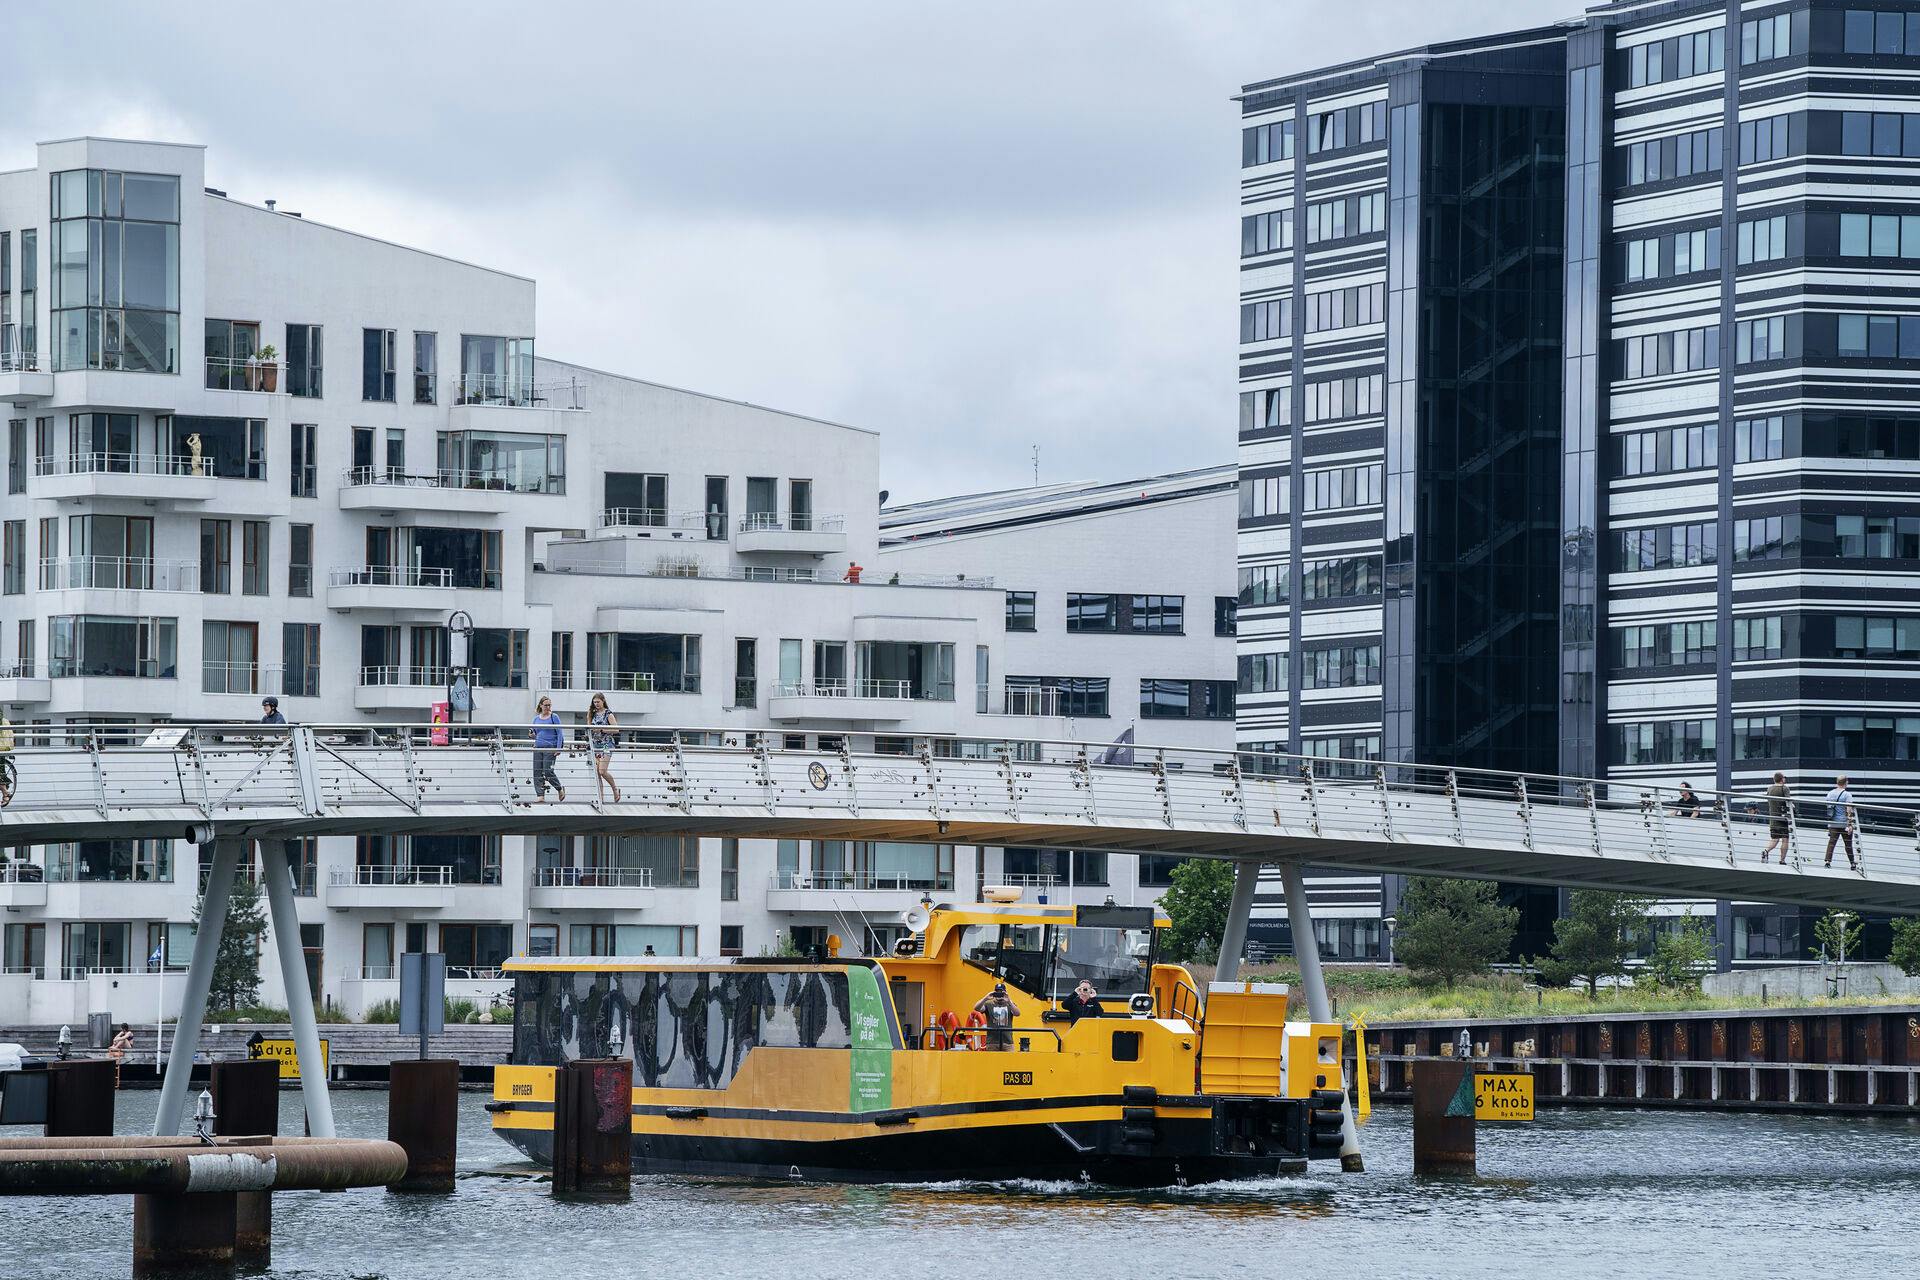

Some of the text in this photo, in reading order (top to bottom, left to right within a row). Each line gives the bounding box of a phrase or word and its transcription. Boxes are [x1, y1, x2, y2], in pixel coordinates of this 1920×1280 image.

[1004, 1073, 1031, 1084] PAS 80
[1483, 1078, 1523, 1092] MAX.
[512, 1084, 533, 1096] BRYGGEN
[1475, 1094, 1529, 1109] 6 knob
